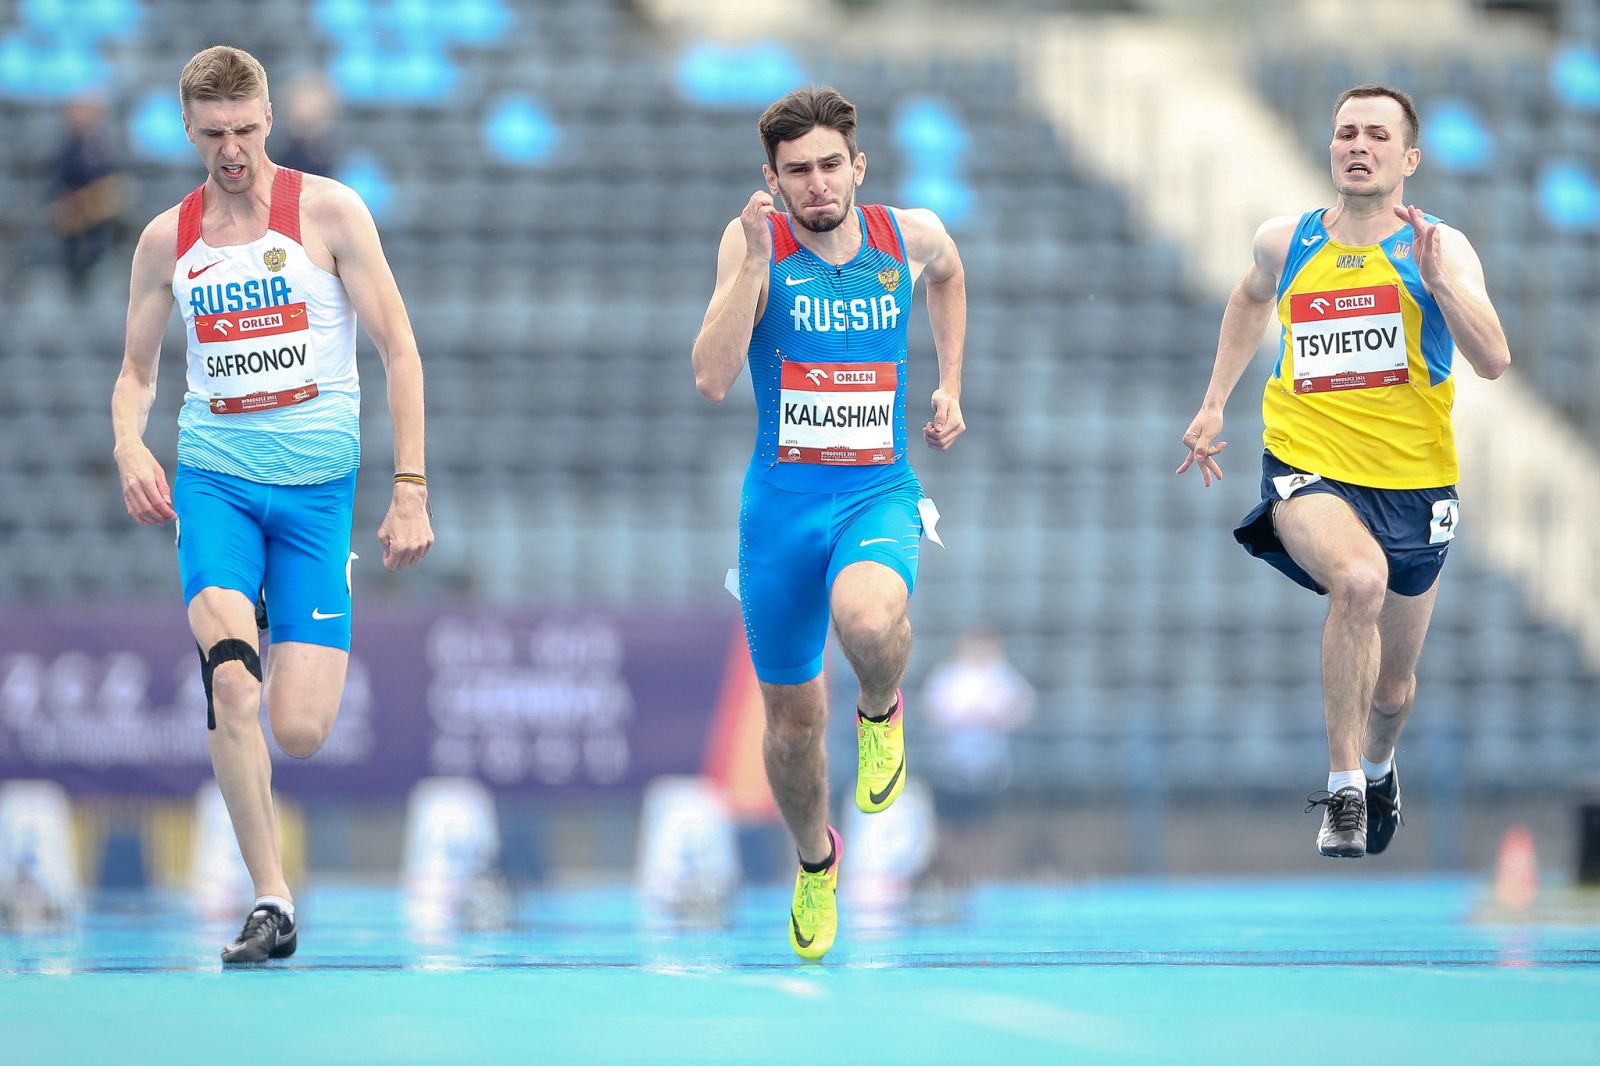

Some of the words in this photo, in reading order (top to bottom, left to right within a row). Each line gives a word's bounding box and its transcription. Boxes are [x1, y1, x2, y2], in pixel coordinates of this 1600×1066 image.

[1336, 254, 1367, 269] UKRAINE
[189, 275, 292, 316] RUSSIA
[1337, 296, 1373, 309] ORLEN
[241, 315, 280, 329] ORLEN
[789, 294, 901, 332] RUSSIA
[1296, 326, 1398, 358] TSVIETOV
[206, 343, 307, 378] SAFRONOV
[835, 372, 874, 382] ORLEN
[784, 402, 890, 428] KALASHIAN
[1289, 476, 1308, 487] 4
[1440, 507, 1453, 532] 4
